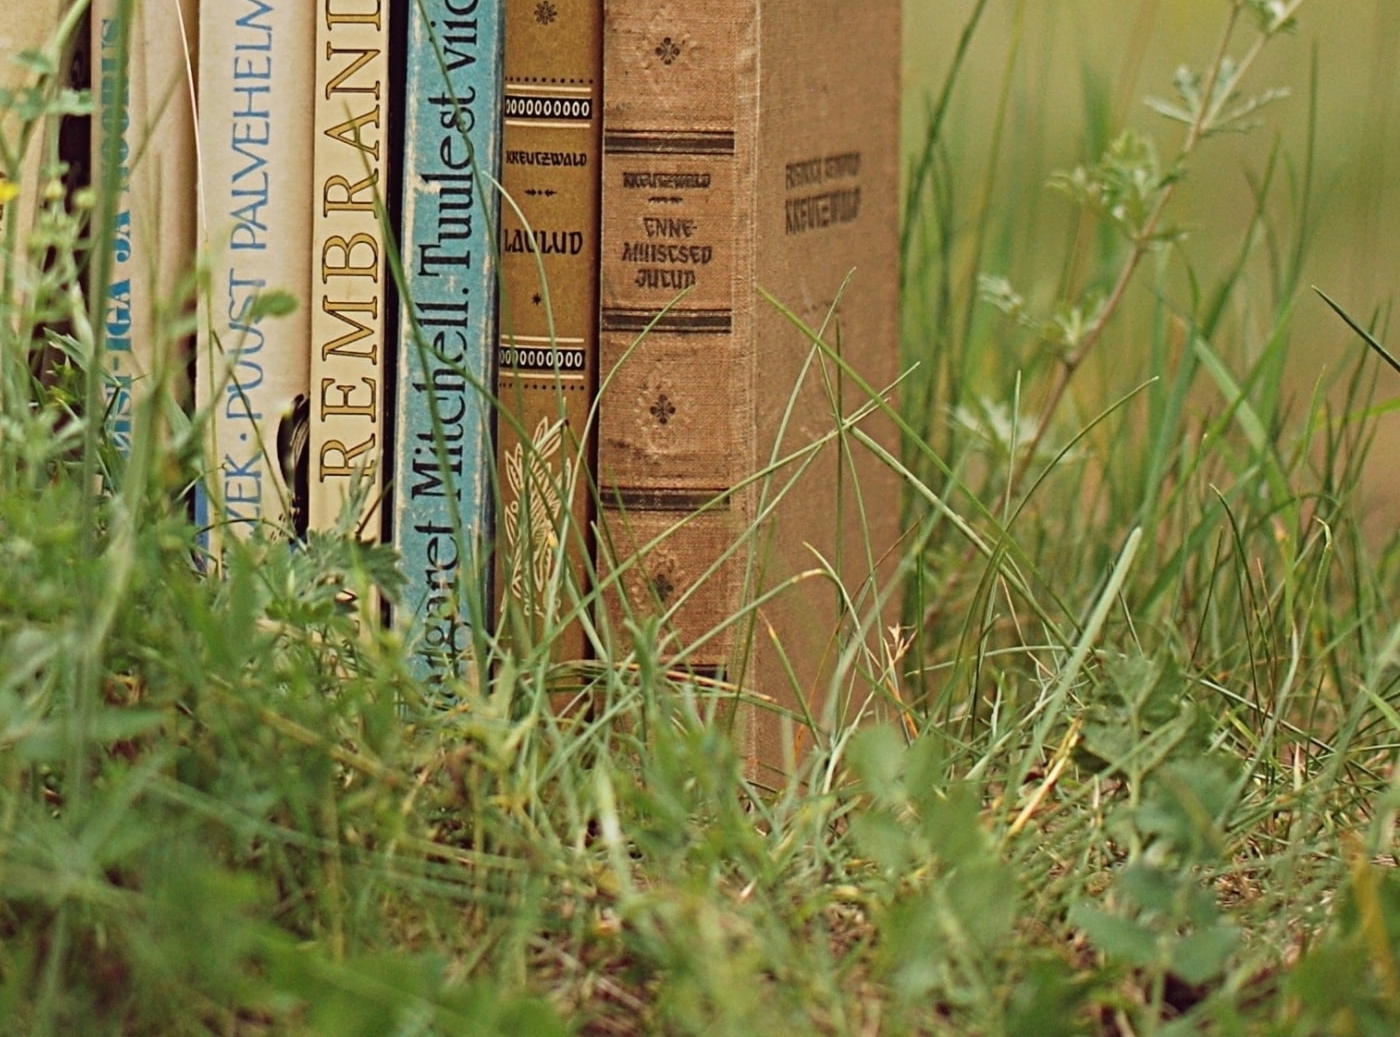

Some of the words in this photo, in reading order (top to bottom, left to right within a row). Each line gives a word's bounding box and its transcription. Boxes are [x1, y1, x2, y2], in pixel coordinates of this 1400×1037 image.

[418, 85, 477, 277] Tuulest
[109, 210, 131, 263] JA
[503, 228, 584, 255] LAULUD
[226, 268, 267, 420] PUUST
